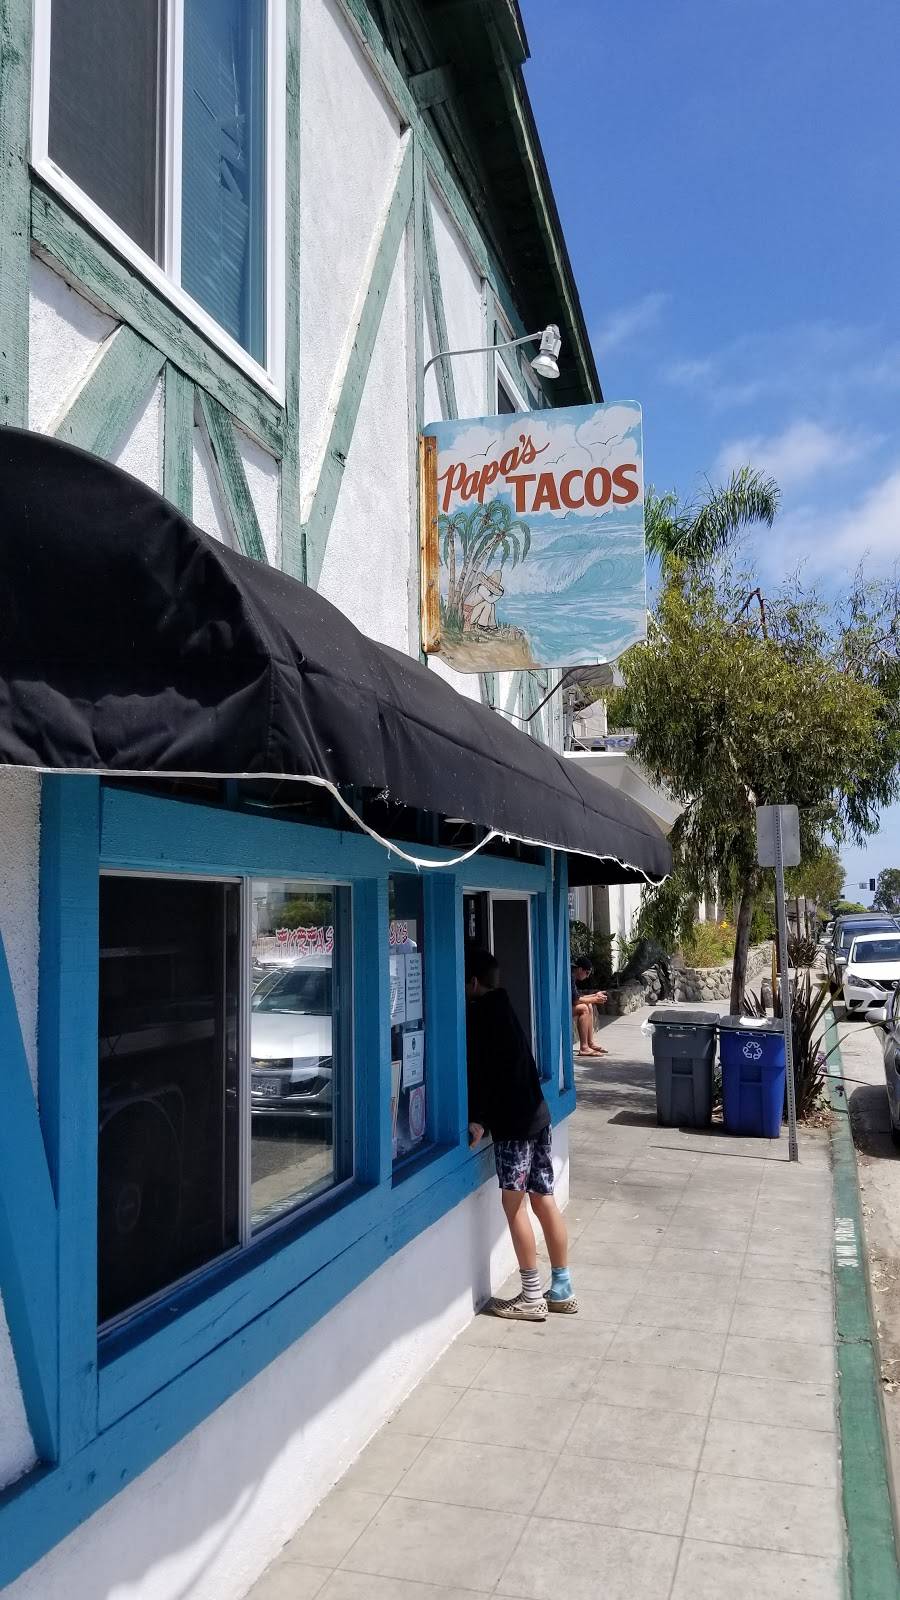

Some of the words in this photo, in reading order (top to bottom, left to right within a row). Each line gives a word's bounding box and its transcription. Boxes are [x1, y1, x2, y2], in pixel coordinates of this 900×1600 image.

[438, 434, 550, 513] Papa's
[506, 464, 639, 513] TACOS
[834, 1217, 857, 1242] PARKING
[836, 1258, 859, 1268] 30
